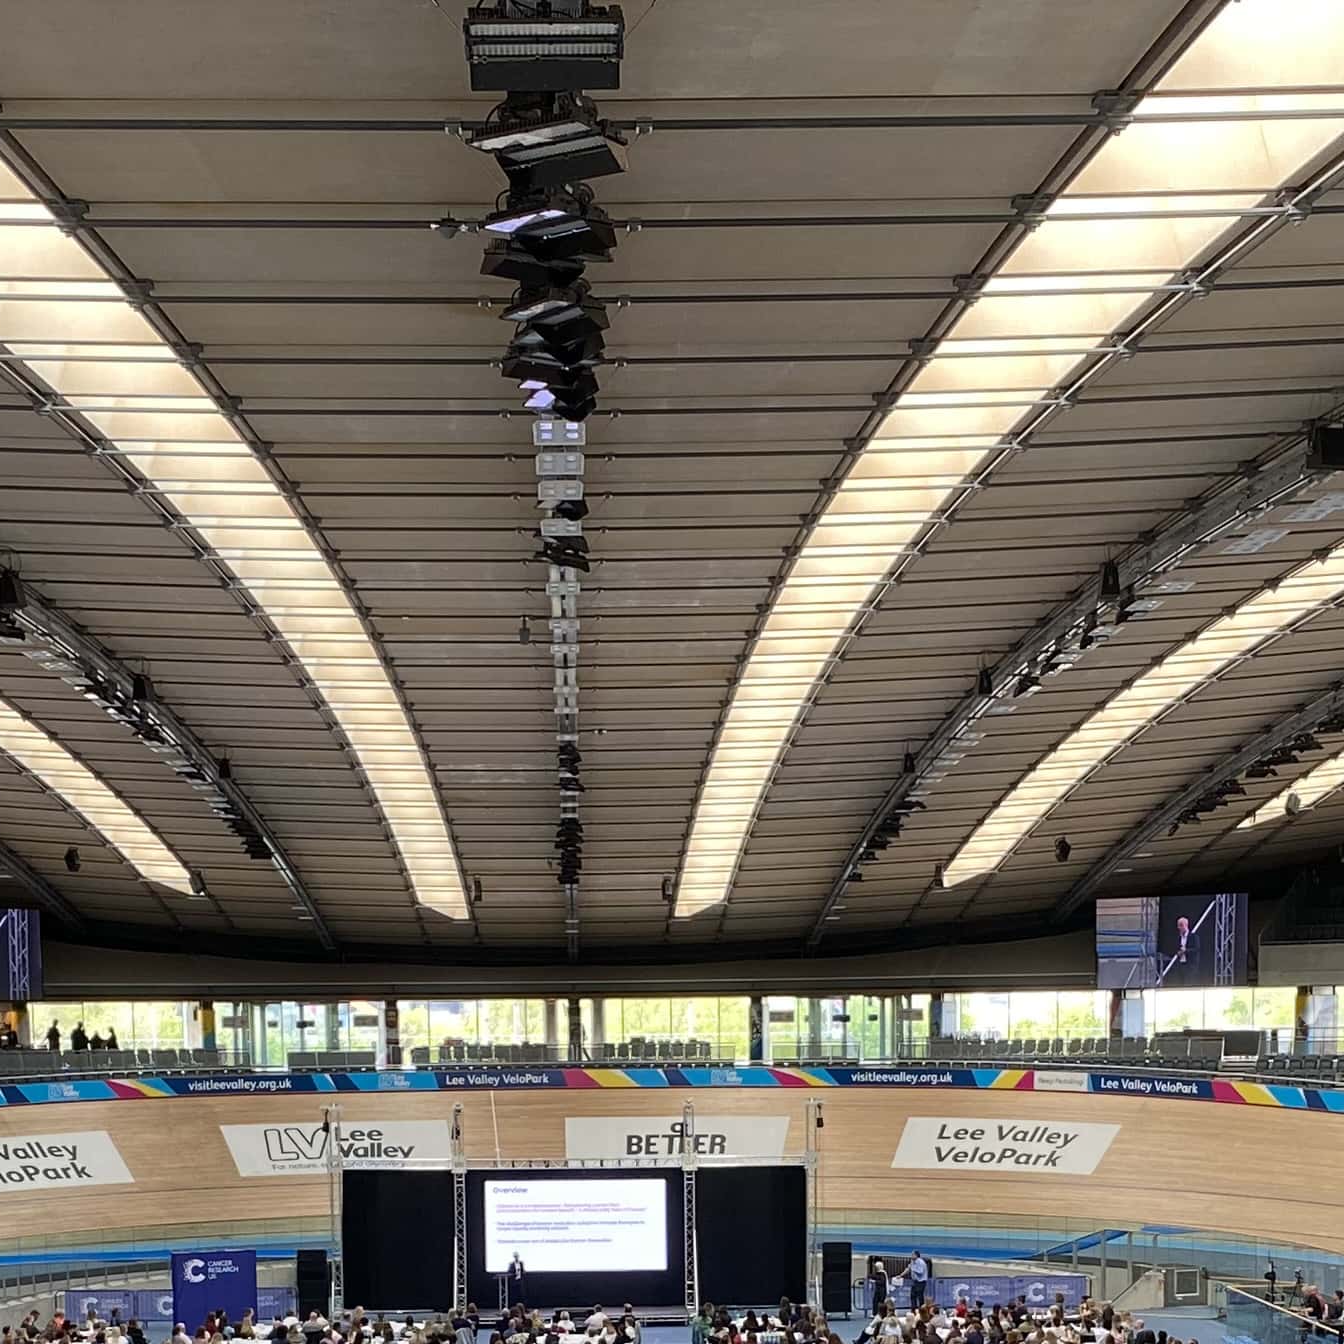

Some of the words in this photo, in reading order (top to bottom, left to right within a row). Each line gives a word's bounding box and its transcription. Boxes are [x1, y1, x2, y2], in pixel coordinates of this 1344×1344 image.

[188, 1077, 292, 1091] visitleevalley.org.uk
[446, 1074, 465, 1085] Lee
[468, 1073, 500, 1087] Valley
[503, 1073, 549, 1085] VeloPark
[851, 1071, 953, 1085] visitleevalley.org.uk
[1101, 1077, 1119, 1089] Lee
[1121, 1079, 1152, 1093] Valley
[1154, 1080, 1199, 1094] VeloPark
[335, 1128, 384, 1142] Lee
[937, 1124, 984, 1141] Lee
[997, 1124, 1079, 1149] Valley
[339, 1143, 415, 1159] Valley
[626, 1134, 727, 1155] BETTER
[934, 1146, 1063, 1167] VeloPark
[208, 1259, 232, 1267] CANCER
